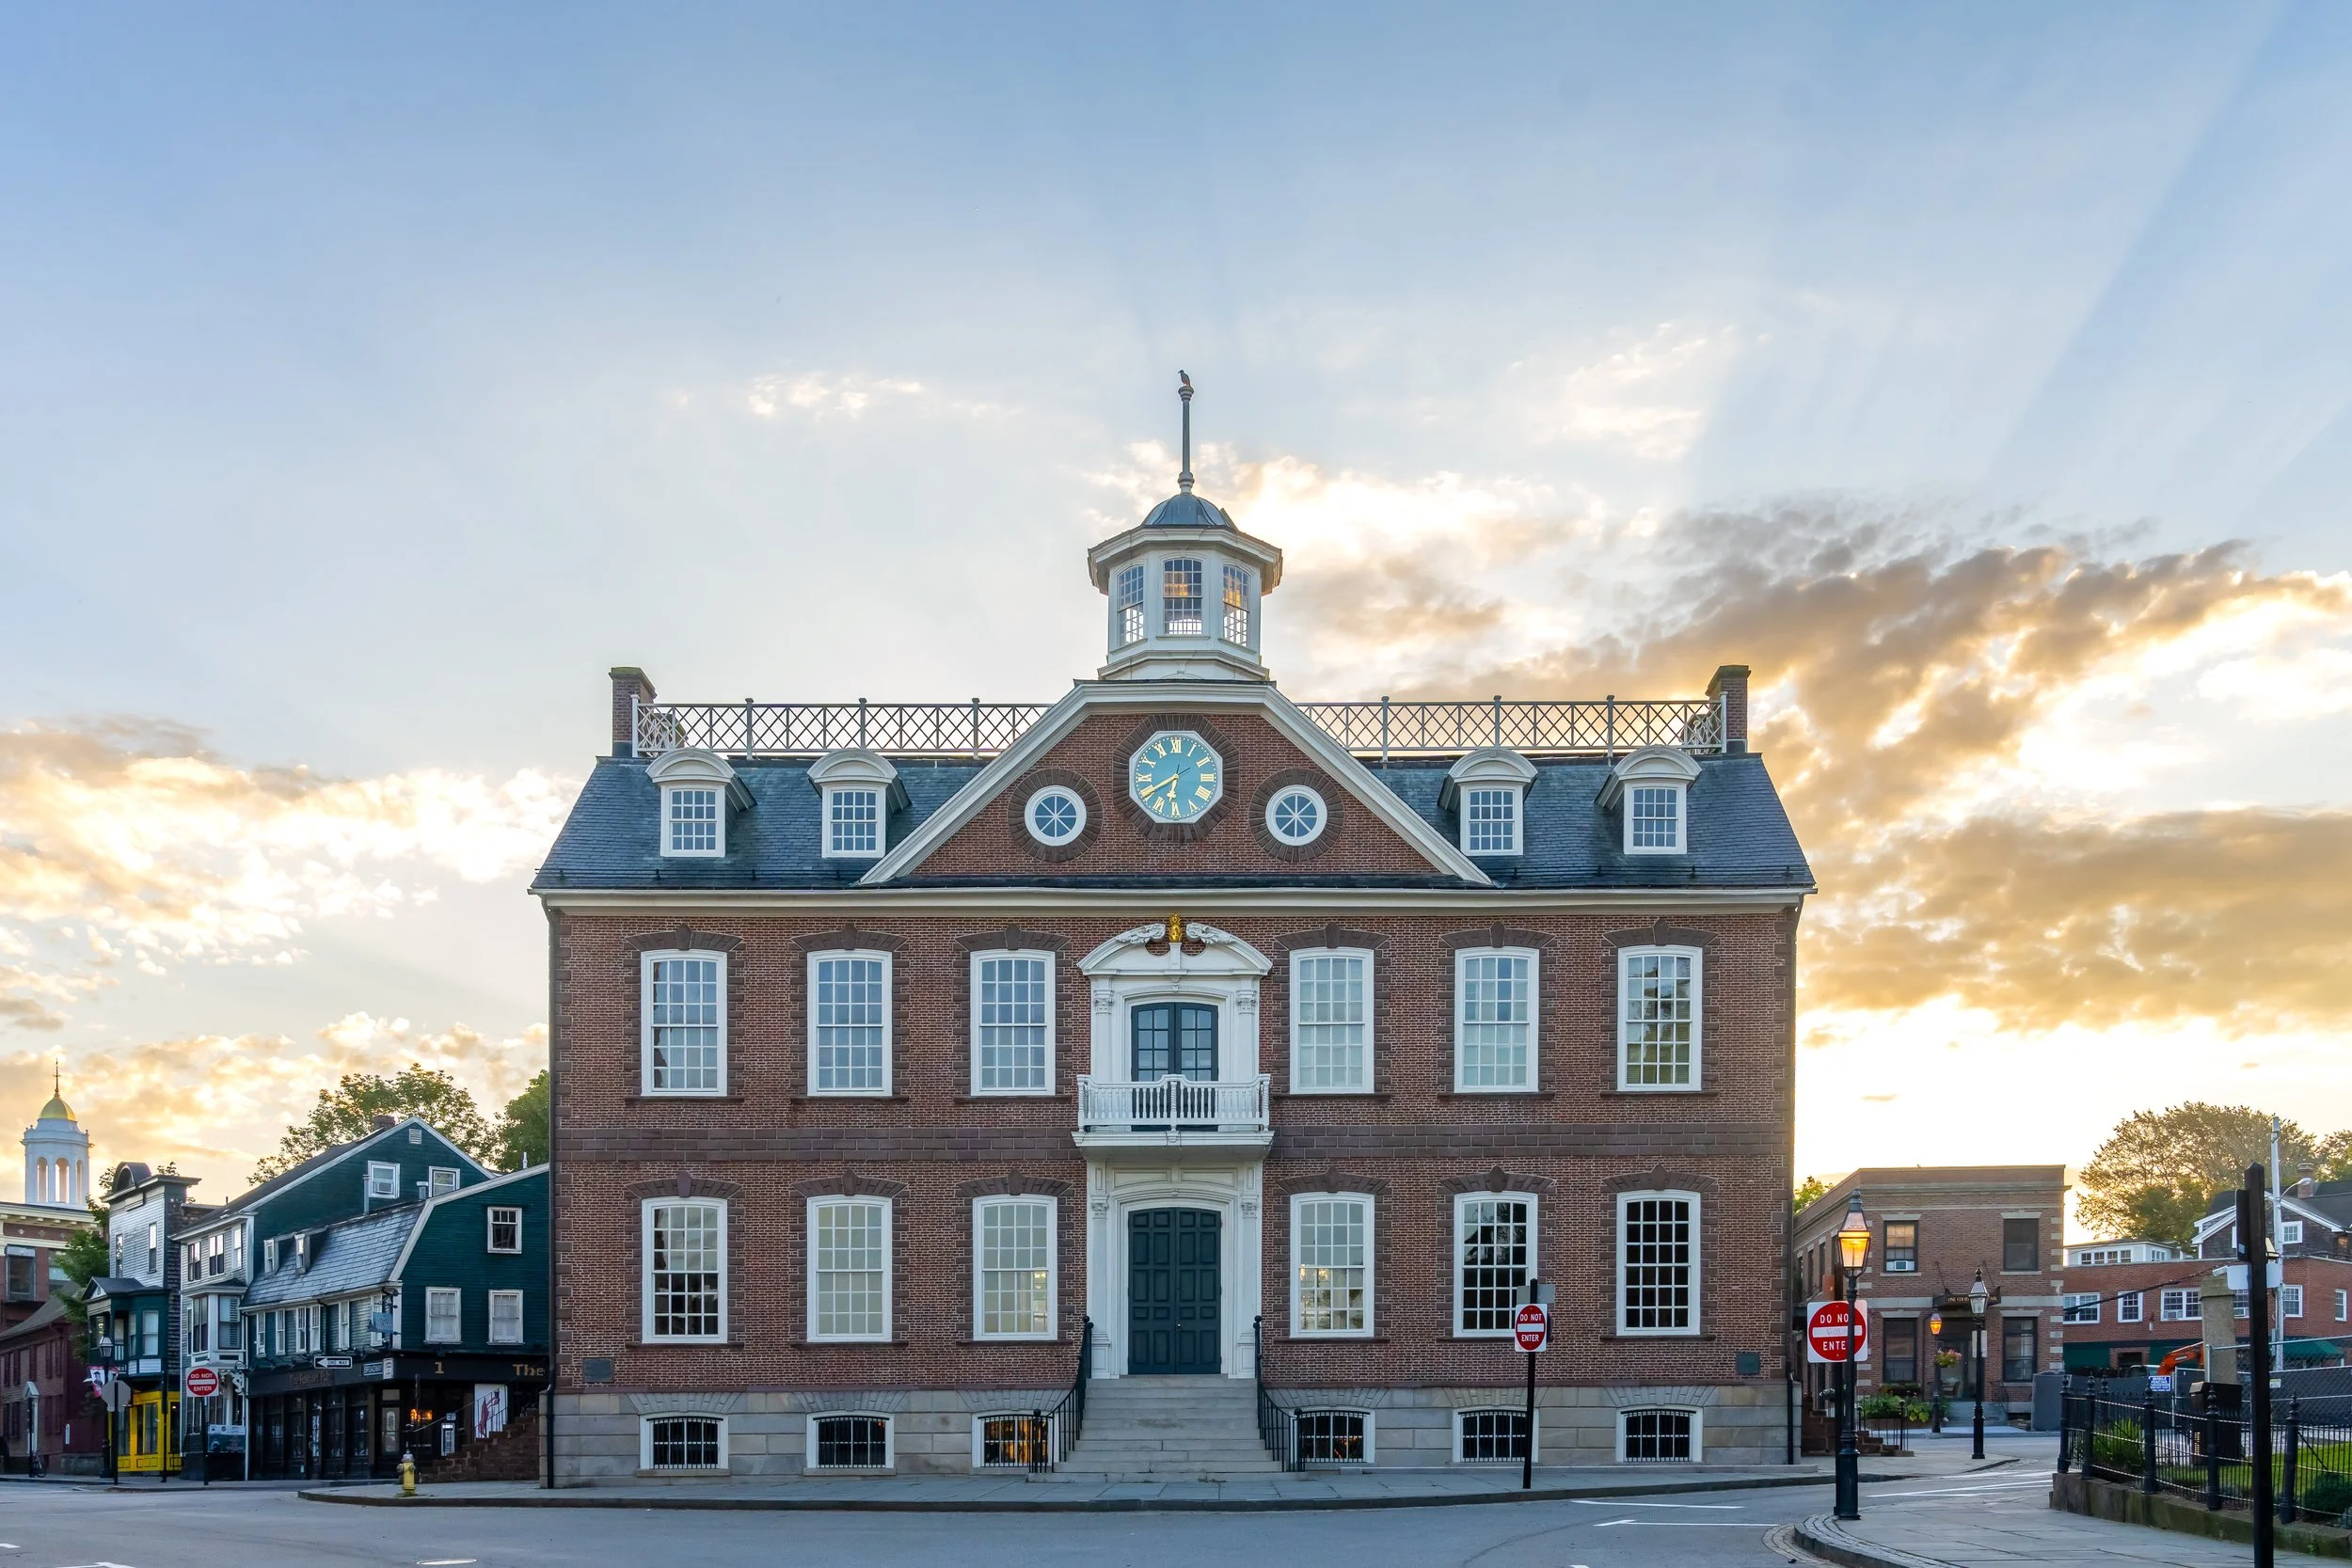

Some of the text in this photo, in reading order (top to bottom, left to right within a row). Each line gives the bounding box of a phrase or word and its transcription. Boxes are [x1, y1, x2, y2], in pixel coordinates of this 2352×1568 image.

[1170, 739, 1182, 753] XII
[1820, 1313, 1849, 1323] DO NO
[1822, 1340, 1846, 1351] ENTE
[435, 1361, 444, 1374] 1
[513, 1364, 545, 1376] The
